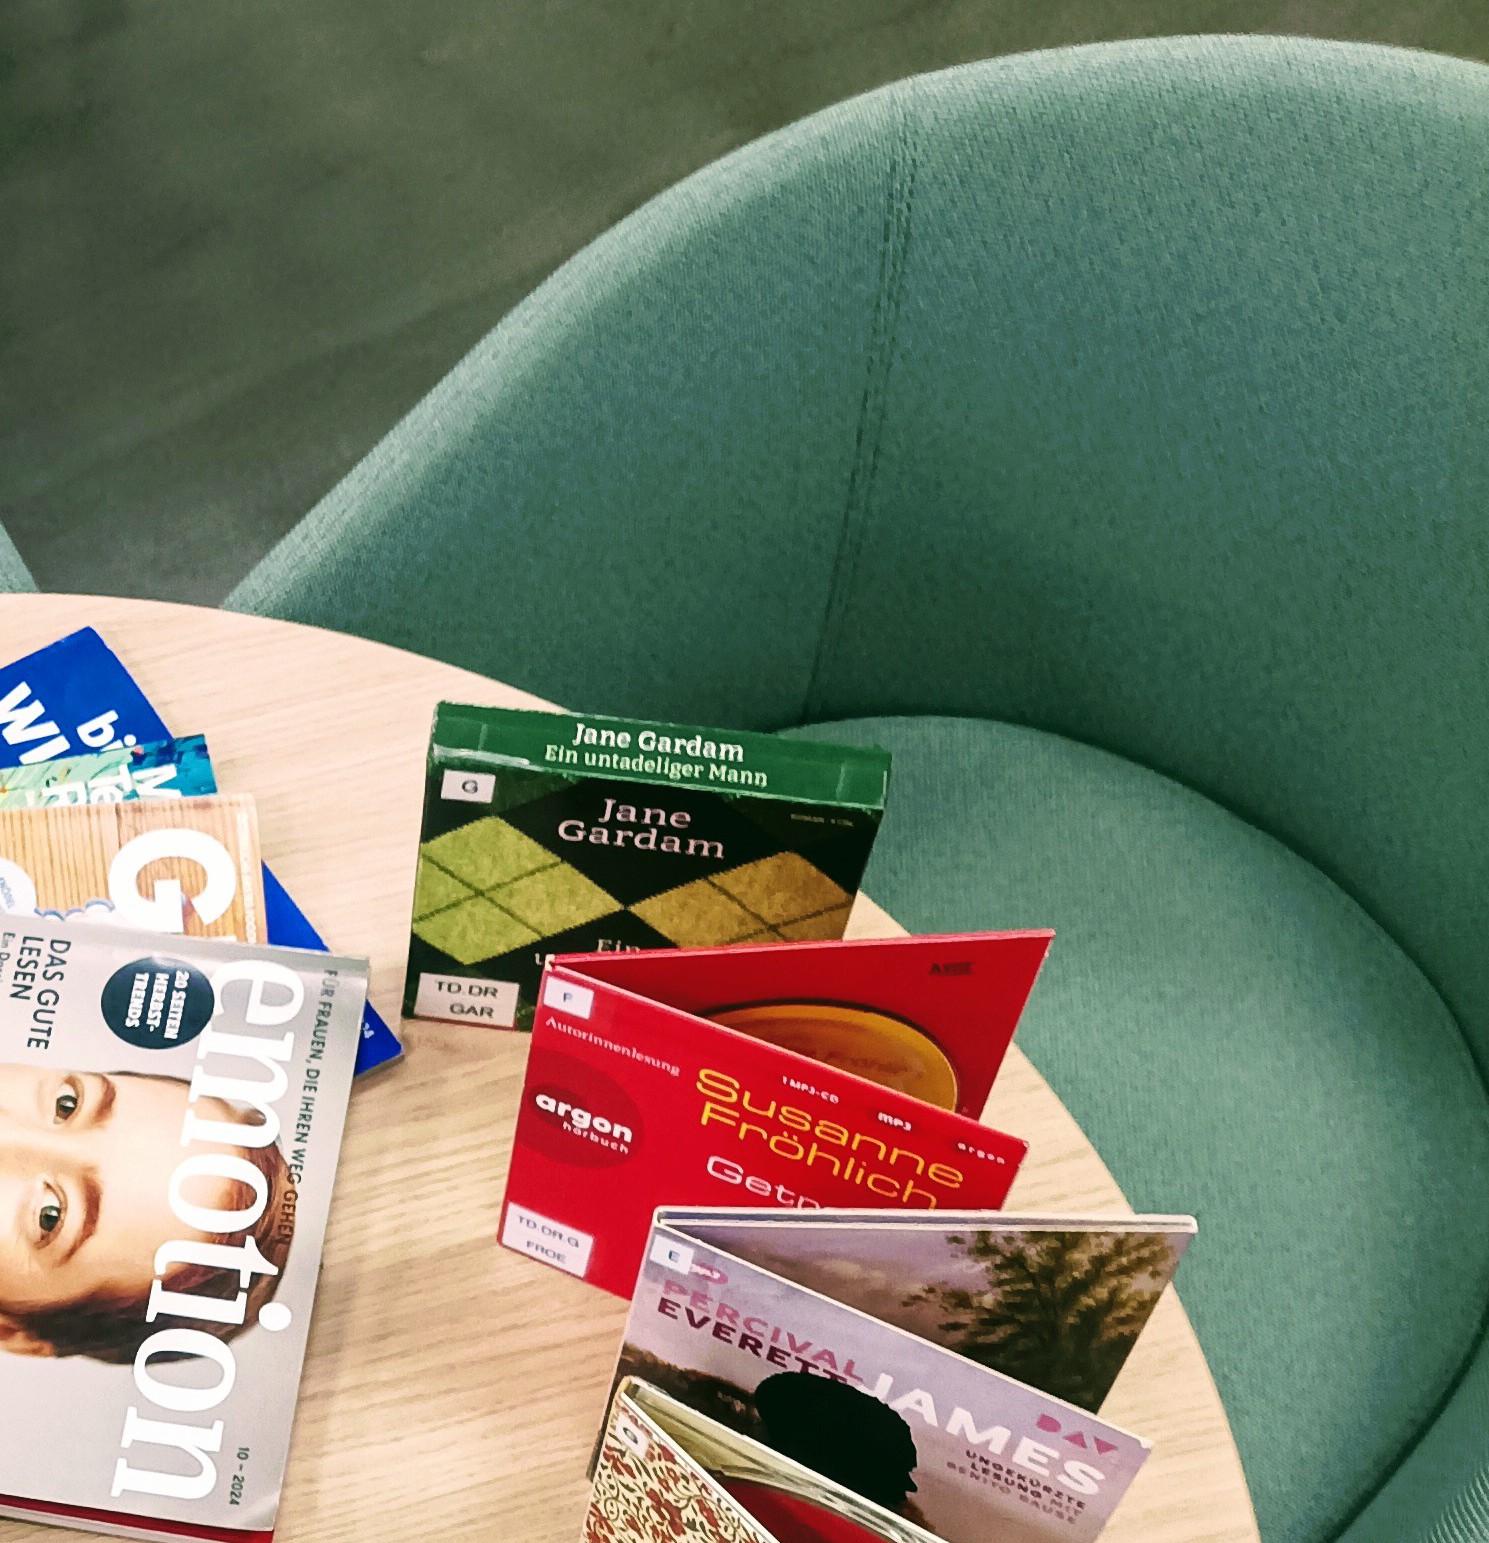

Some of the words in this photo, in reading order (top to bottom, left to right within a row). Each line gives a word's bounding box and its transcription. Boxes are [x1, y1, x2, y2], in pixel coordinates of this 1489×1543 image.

[544, 744, 577, 763] Ein
[584, 752, 704, 779] untadeliger
[708, 762, 767, 787] Mann
[571, 722, 631, 748] Jane
[637, 730, 743, 762] Gardam
[597, 798, 691, 828] Jane
[557, 819, 723, 858] Gardam
[109, 827, 238, 934] G
[2, 931, 16, 948] Ein
[41, 938, 71, 981] DAS
[9, 935, 44, 1000] LESEN
[174, 968, 189, 988] 20
[320, 968, 338, 997] FÜR
[26, 988, 59, 1049] GUTE
[125, 972, 149, 1027] TRENDS
[146, 972, 169, 1031] HERBST-
[163, 989, 186, 1039] SEITEN
[449, 1003, 493, 1017] GAR
[309, 1001, 332, 1059] FRAUEN,
[545, 1016, 679, 1076] Autorinnenlesung
[302, 1068, 320, 1092] DIE
[294, 1095, 314, 1143] IHREN
[535, 1094, 632, 1142] argon
[696, 1068, 963, 1187] Susanne
[284, 1147, 305, 1185] WEG
[700, 1101, 938, 1214] Fröhlich
[114, 960, 305, 1503] emotion
[274, 1189, 298, 1245] GEHEN
[664, 1278, 863, 1382] PERCIVAL
[236, 1447, 249, 1460] 10
[853, 1372, 1104, 1494] JAMES
[228, 1474, 244, 1505] 2024
[965, 1449, 1084, 1509] UNGEKÜRZTE
[970, 1461, 1041, 1498] LESUNG
